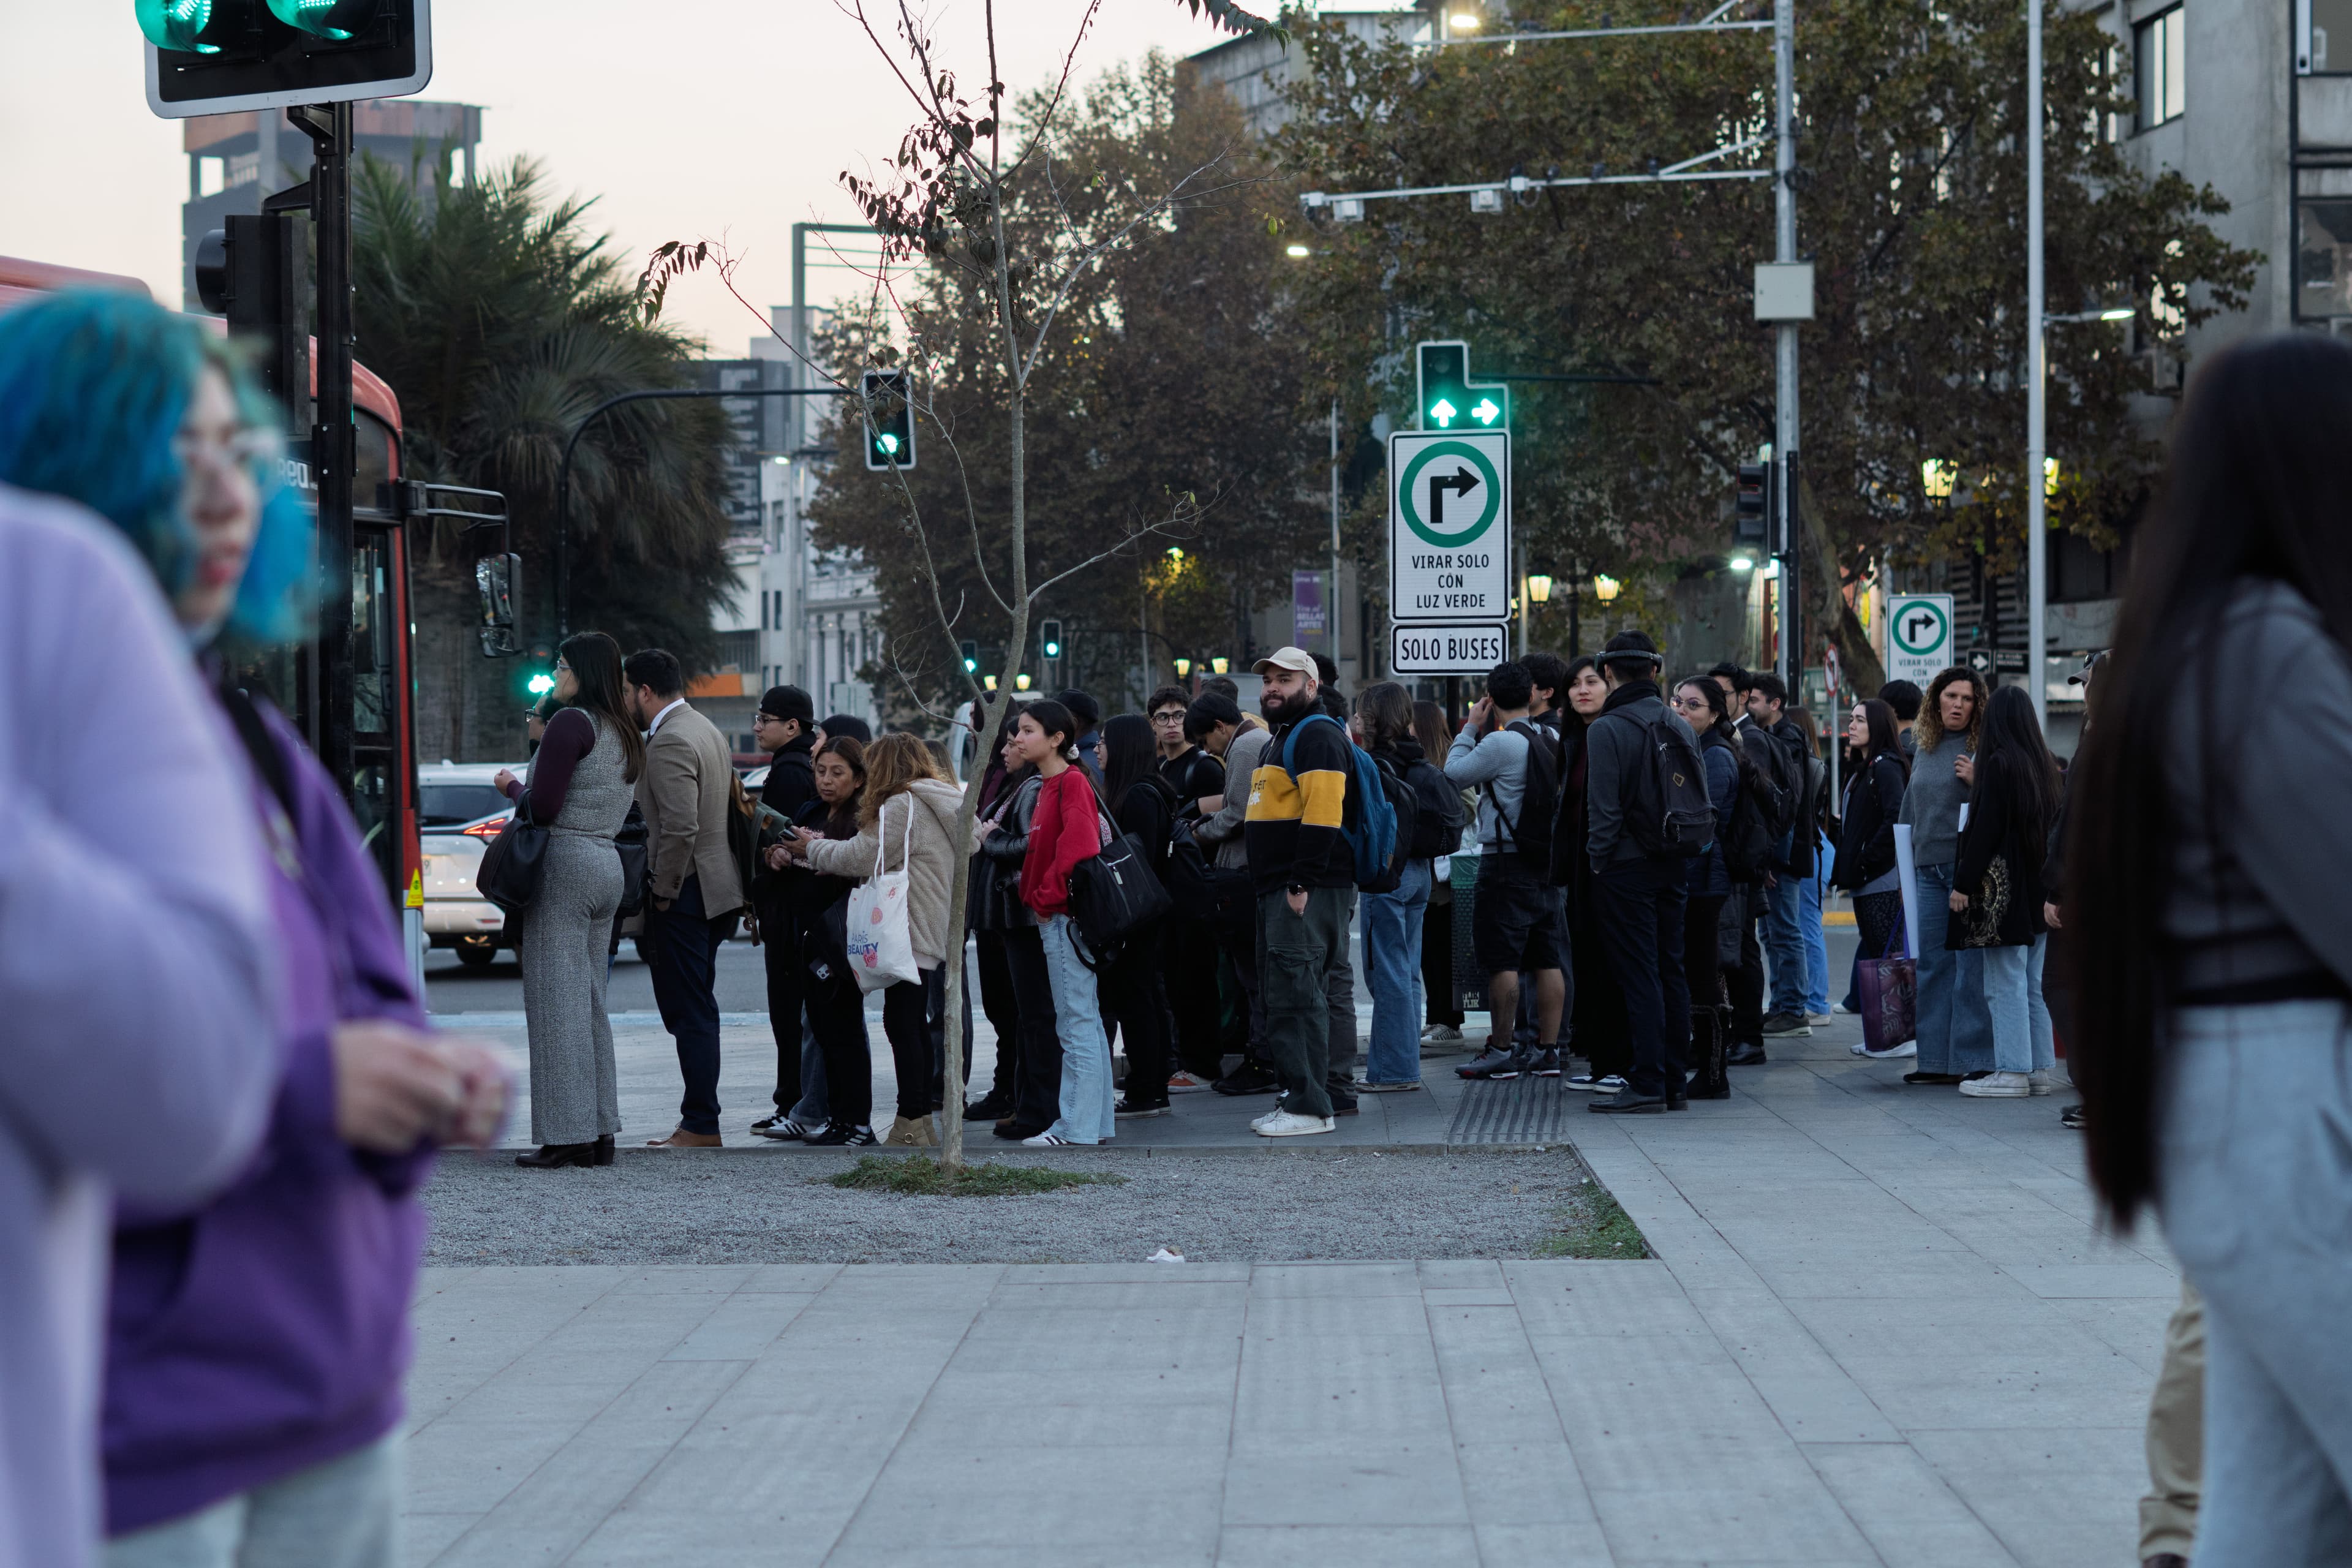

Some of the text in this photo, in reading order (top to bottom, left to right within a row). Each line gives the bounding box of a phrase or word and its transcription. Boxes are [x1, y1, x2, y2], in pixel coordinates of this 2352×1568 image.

[1412, 554, 1489, 568] VIRAR SOLO
[1438, 574, 1463, 588] CON
[1417, 594, 1485, 608] LUZ VERDE
[1401, 638, 1499, 660] SOLO BUSES
[852, 931, 868, 943] PARIS
[848, 942, 878, 956] BEAUTY
